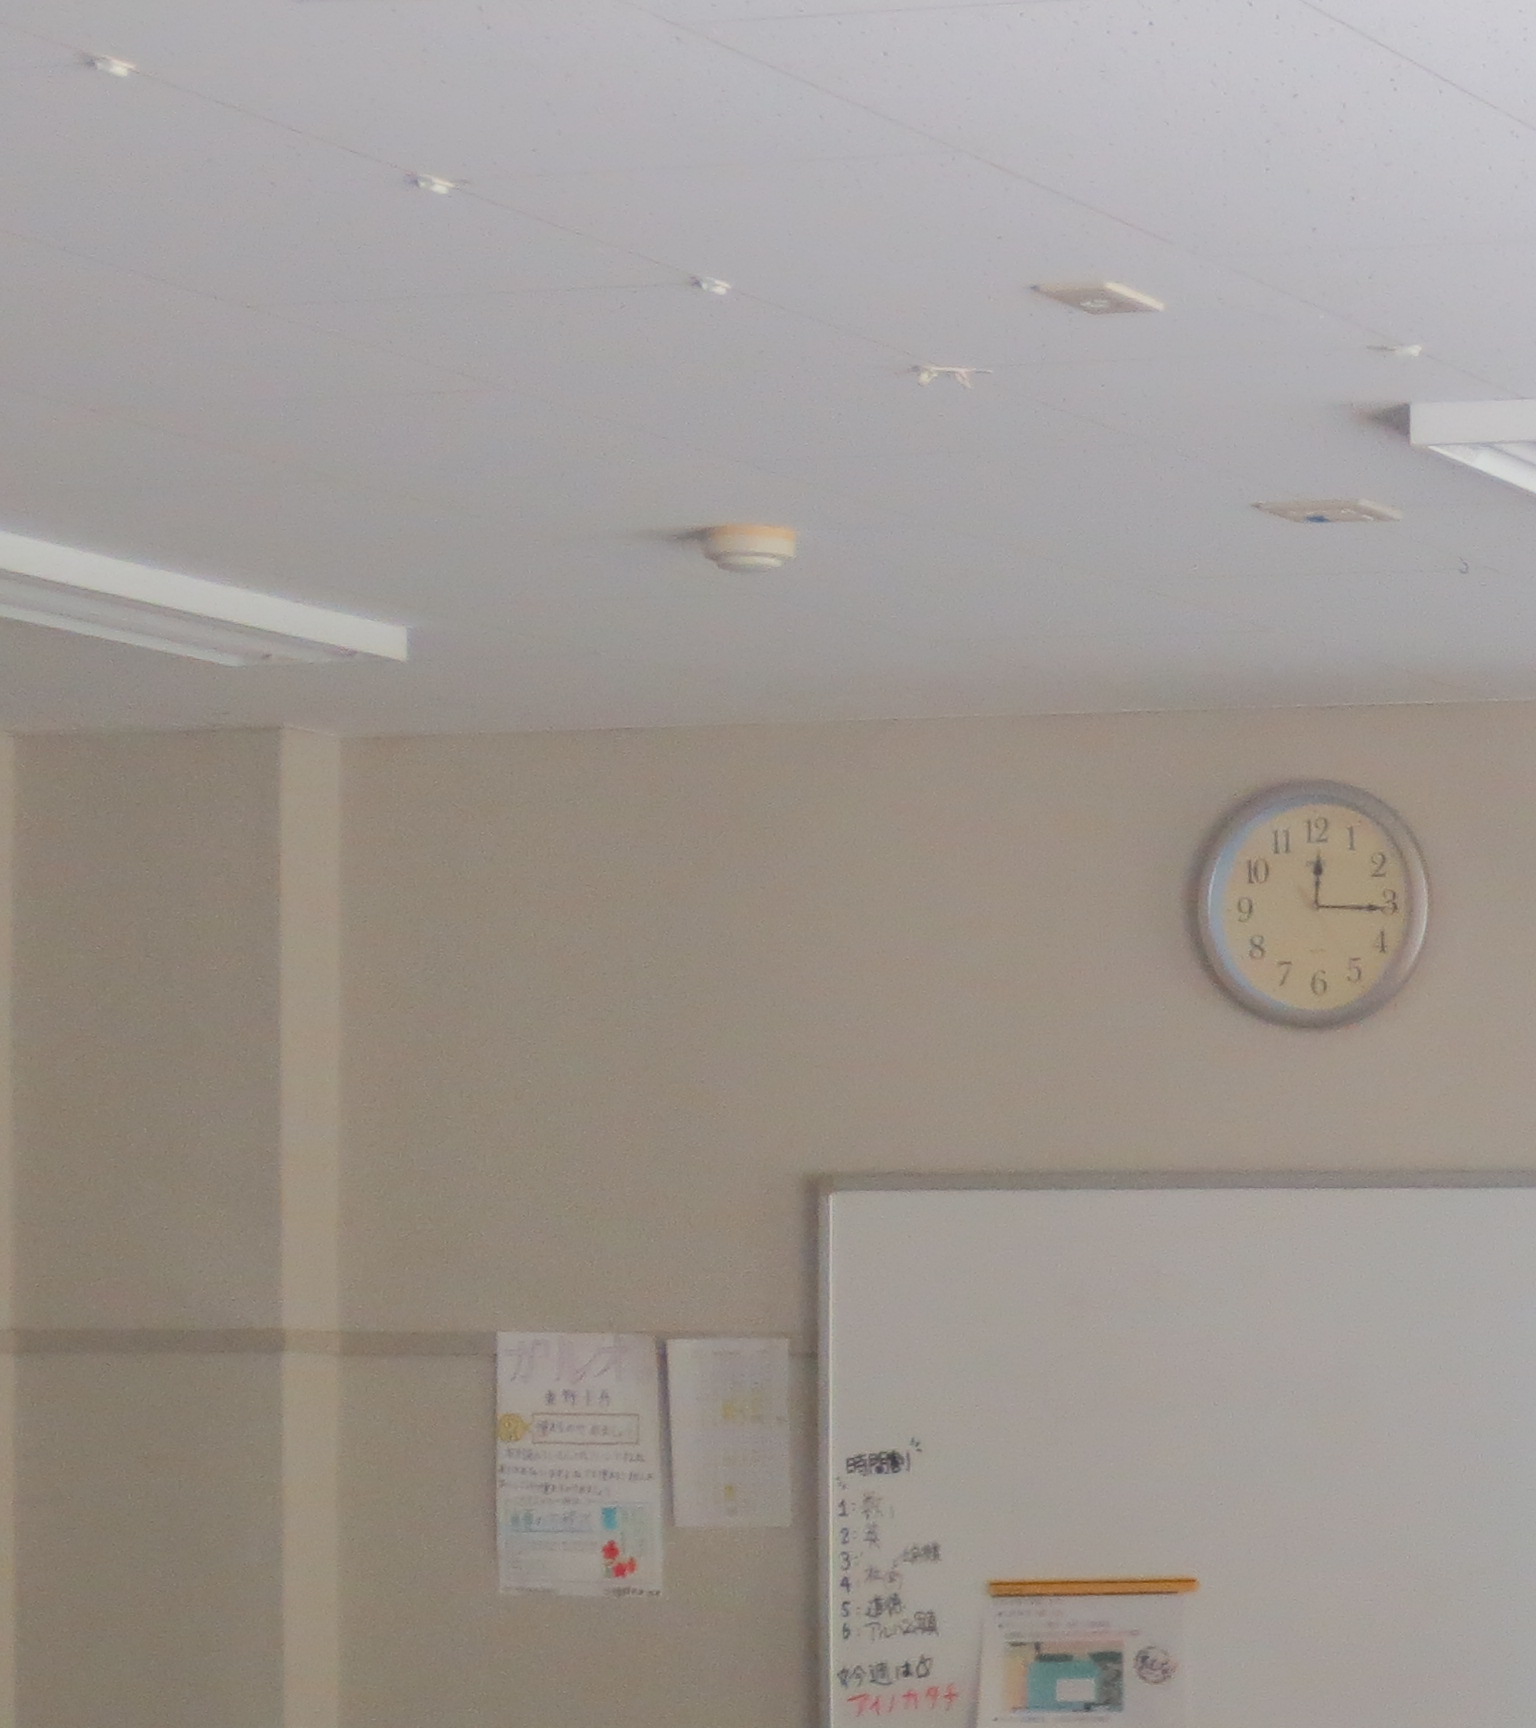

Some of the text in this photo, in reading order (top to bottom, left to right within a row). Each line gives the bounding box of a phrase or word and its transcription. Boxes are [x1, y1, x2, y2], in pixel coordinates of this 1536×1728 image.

[1273, 827, 1291, 854] 11
[1305, 817, 1329, 843] 12
[1347, 825, 1357, 851] 1
[1247, 858, 1270, 884] 10
[1371, 852, 1387, 878] 2
[1237, 898, 1253, 923] 9
[1382, 889, 1398, 915] 3
[1250, 935, 1265, 959] 8
[1376, 930, 1386, 953] 4
[1277, 961, 1292, 986] 7
[1347, 957, 1362, 982] 5
[1310, 970, 1327, 996] 6
